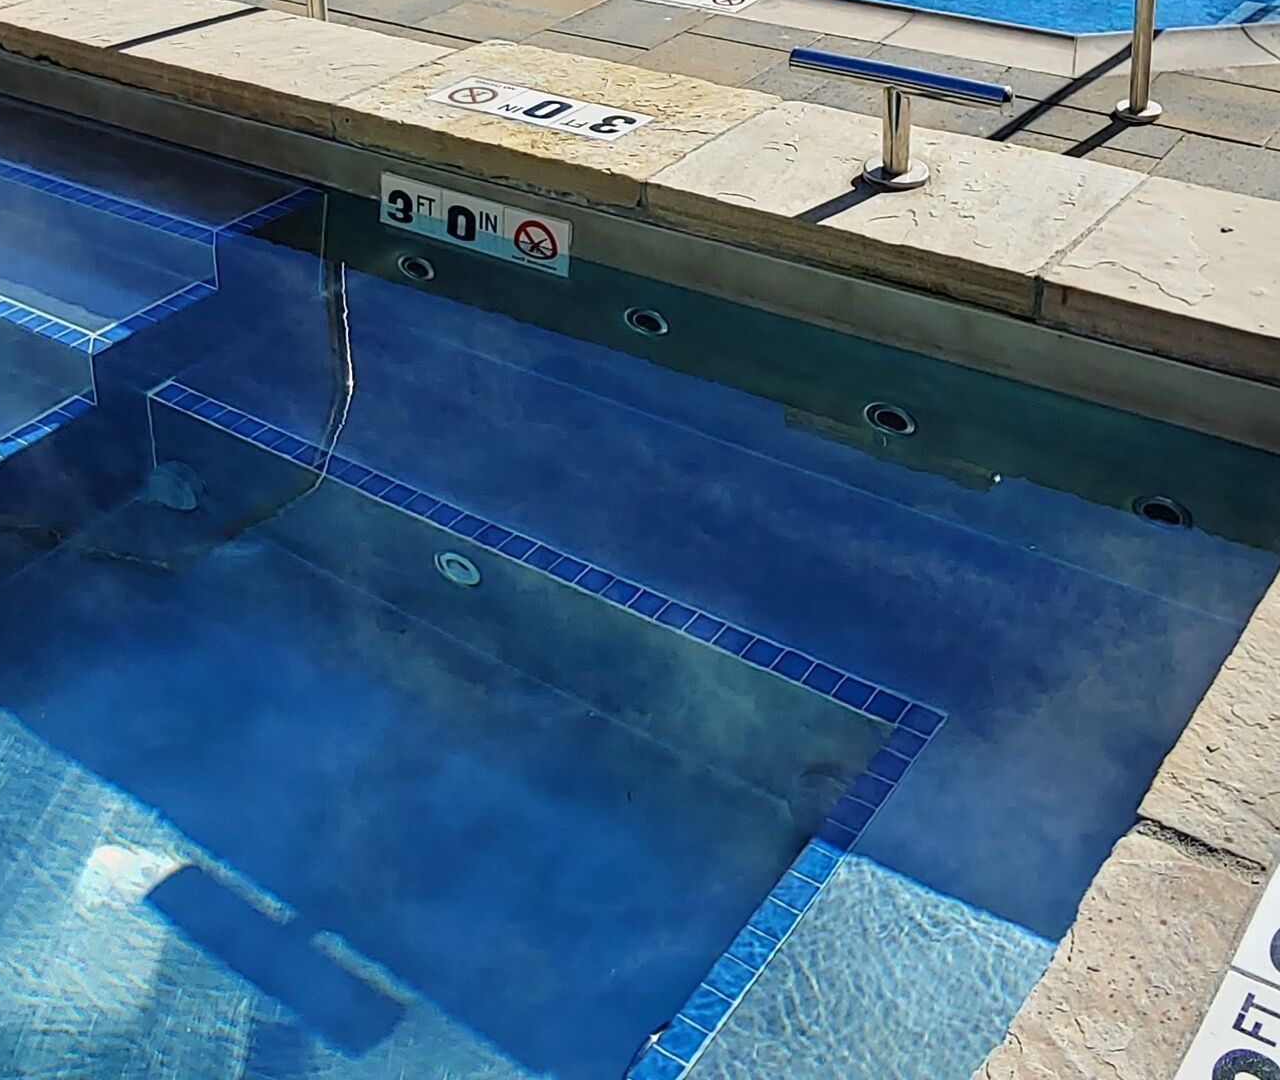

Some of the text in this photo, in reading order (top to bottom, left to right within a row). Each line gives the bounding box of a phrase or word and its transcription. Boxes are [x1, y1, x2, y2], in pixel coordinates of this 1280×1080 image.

[497, 100, 638, 134] 3 FT 0 IN
[387, 189, 498, 242] 3 FT 0 IN
